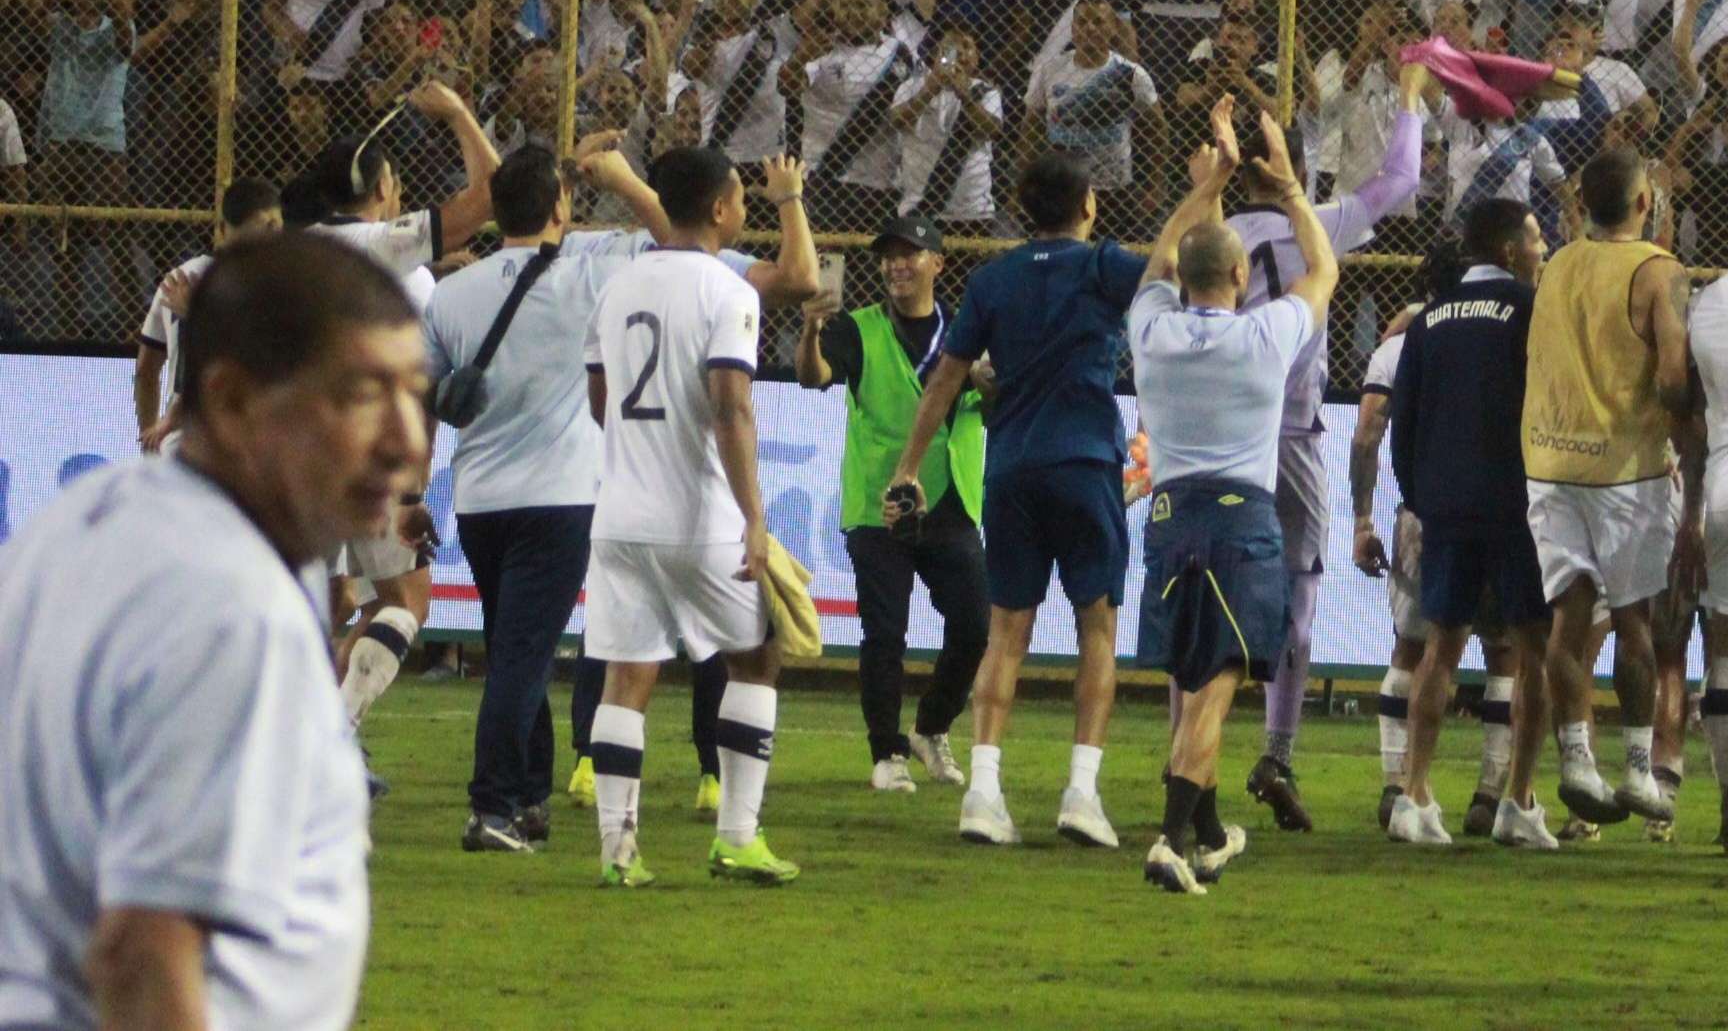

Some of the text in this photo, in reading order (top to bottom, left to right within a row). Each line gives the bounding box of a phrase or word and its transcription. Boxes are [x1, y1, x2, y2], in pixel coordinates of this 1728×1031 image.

[1250, 240, 1282, 299] 1
[1425, 299, 1515, 329] GUATEMALA
[620, 311, 666, 421] 2
